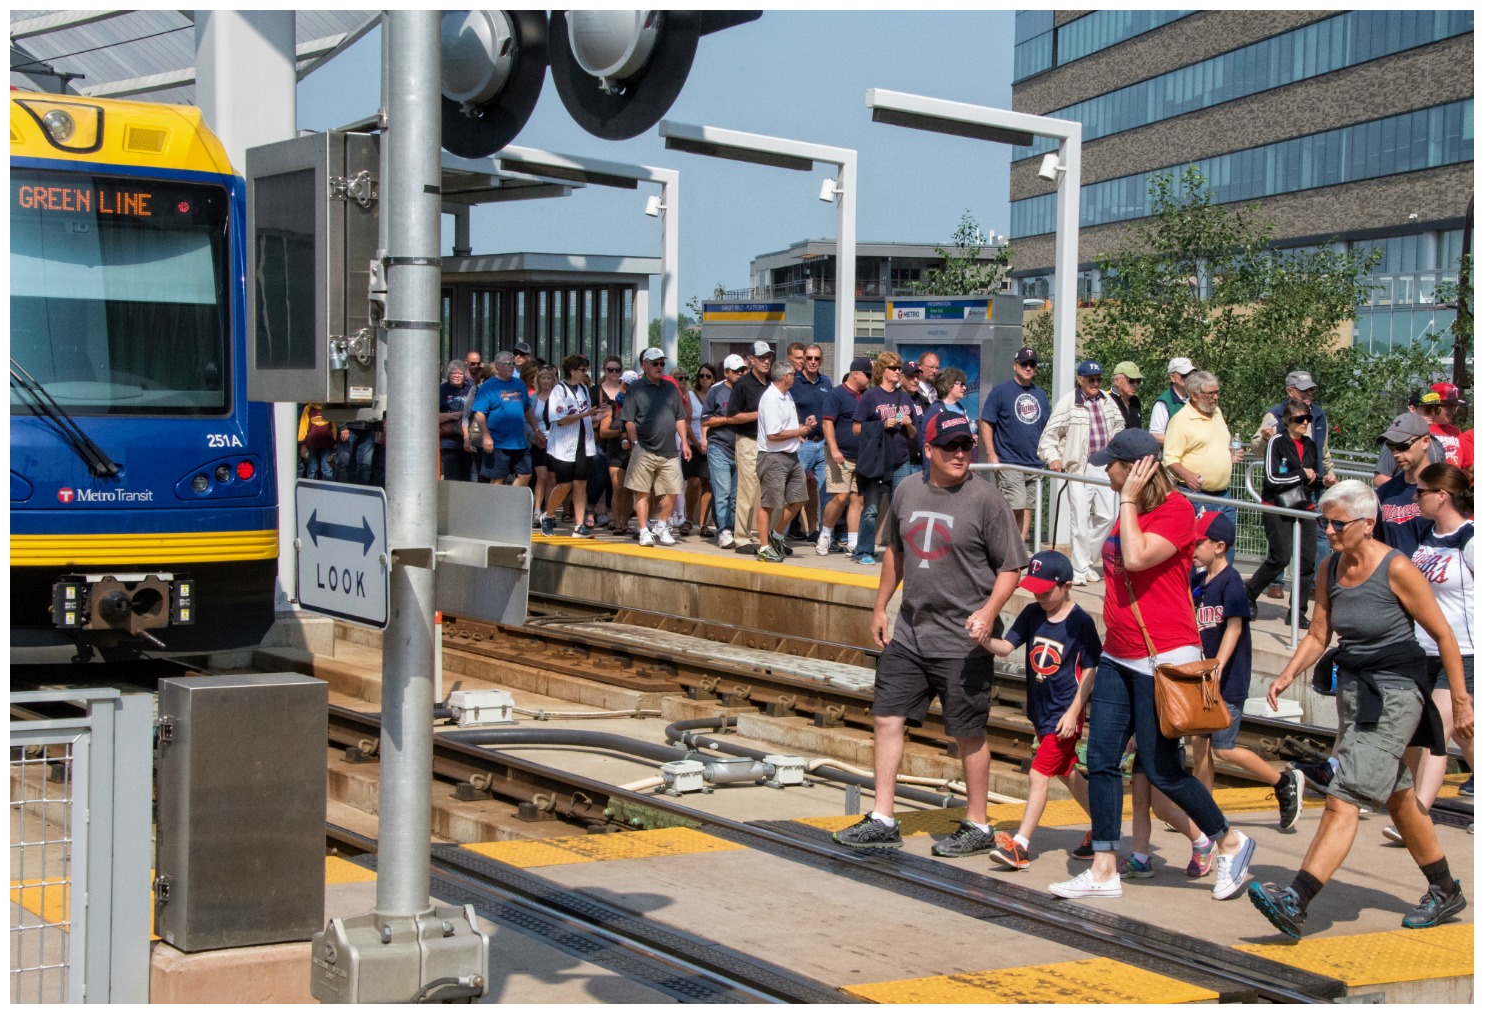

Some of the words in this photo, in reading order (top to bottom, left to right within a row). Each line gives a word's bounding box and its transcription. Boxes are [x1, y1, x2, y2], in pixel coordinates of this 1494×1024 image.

[19, 185, 91, 212] GREEN
[99, 190, 152, 216] LINE
[206, 434, 243, 448] 251A
[316, 562, 366, 599] LOOK
